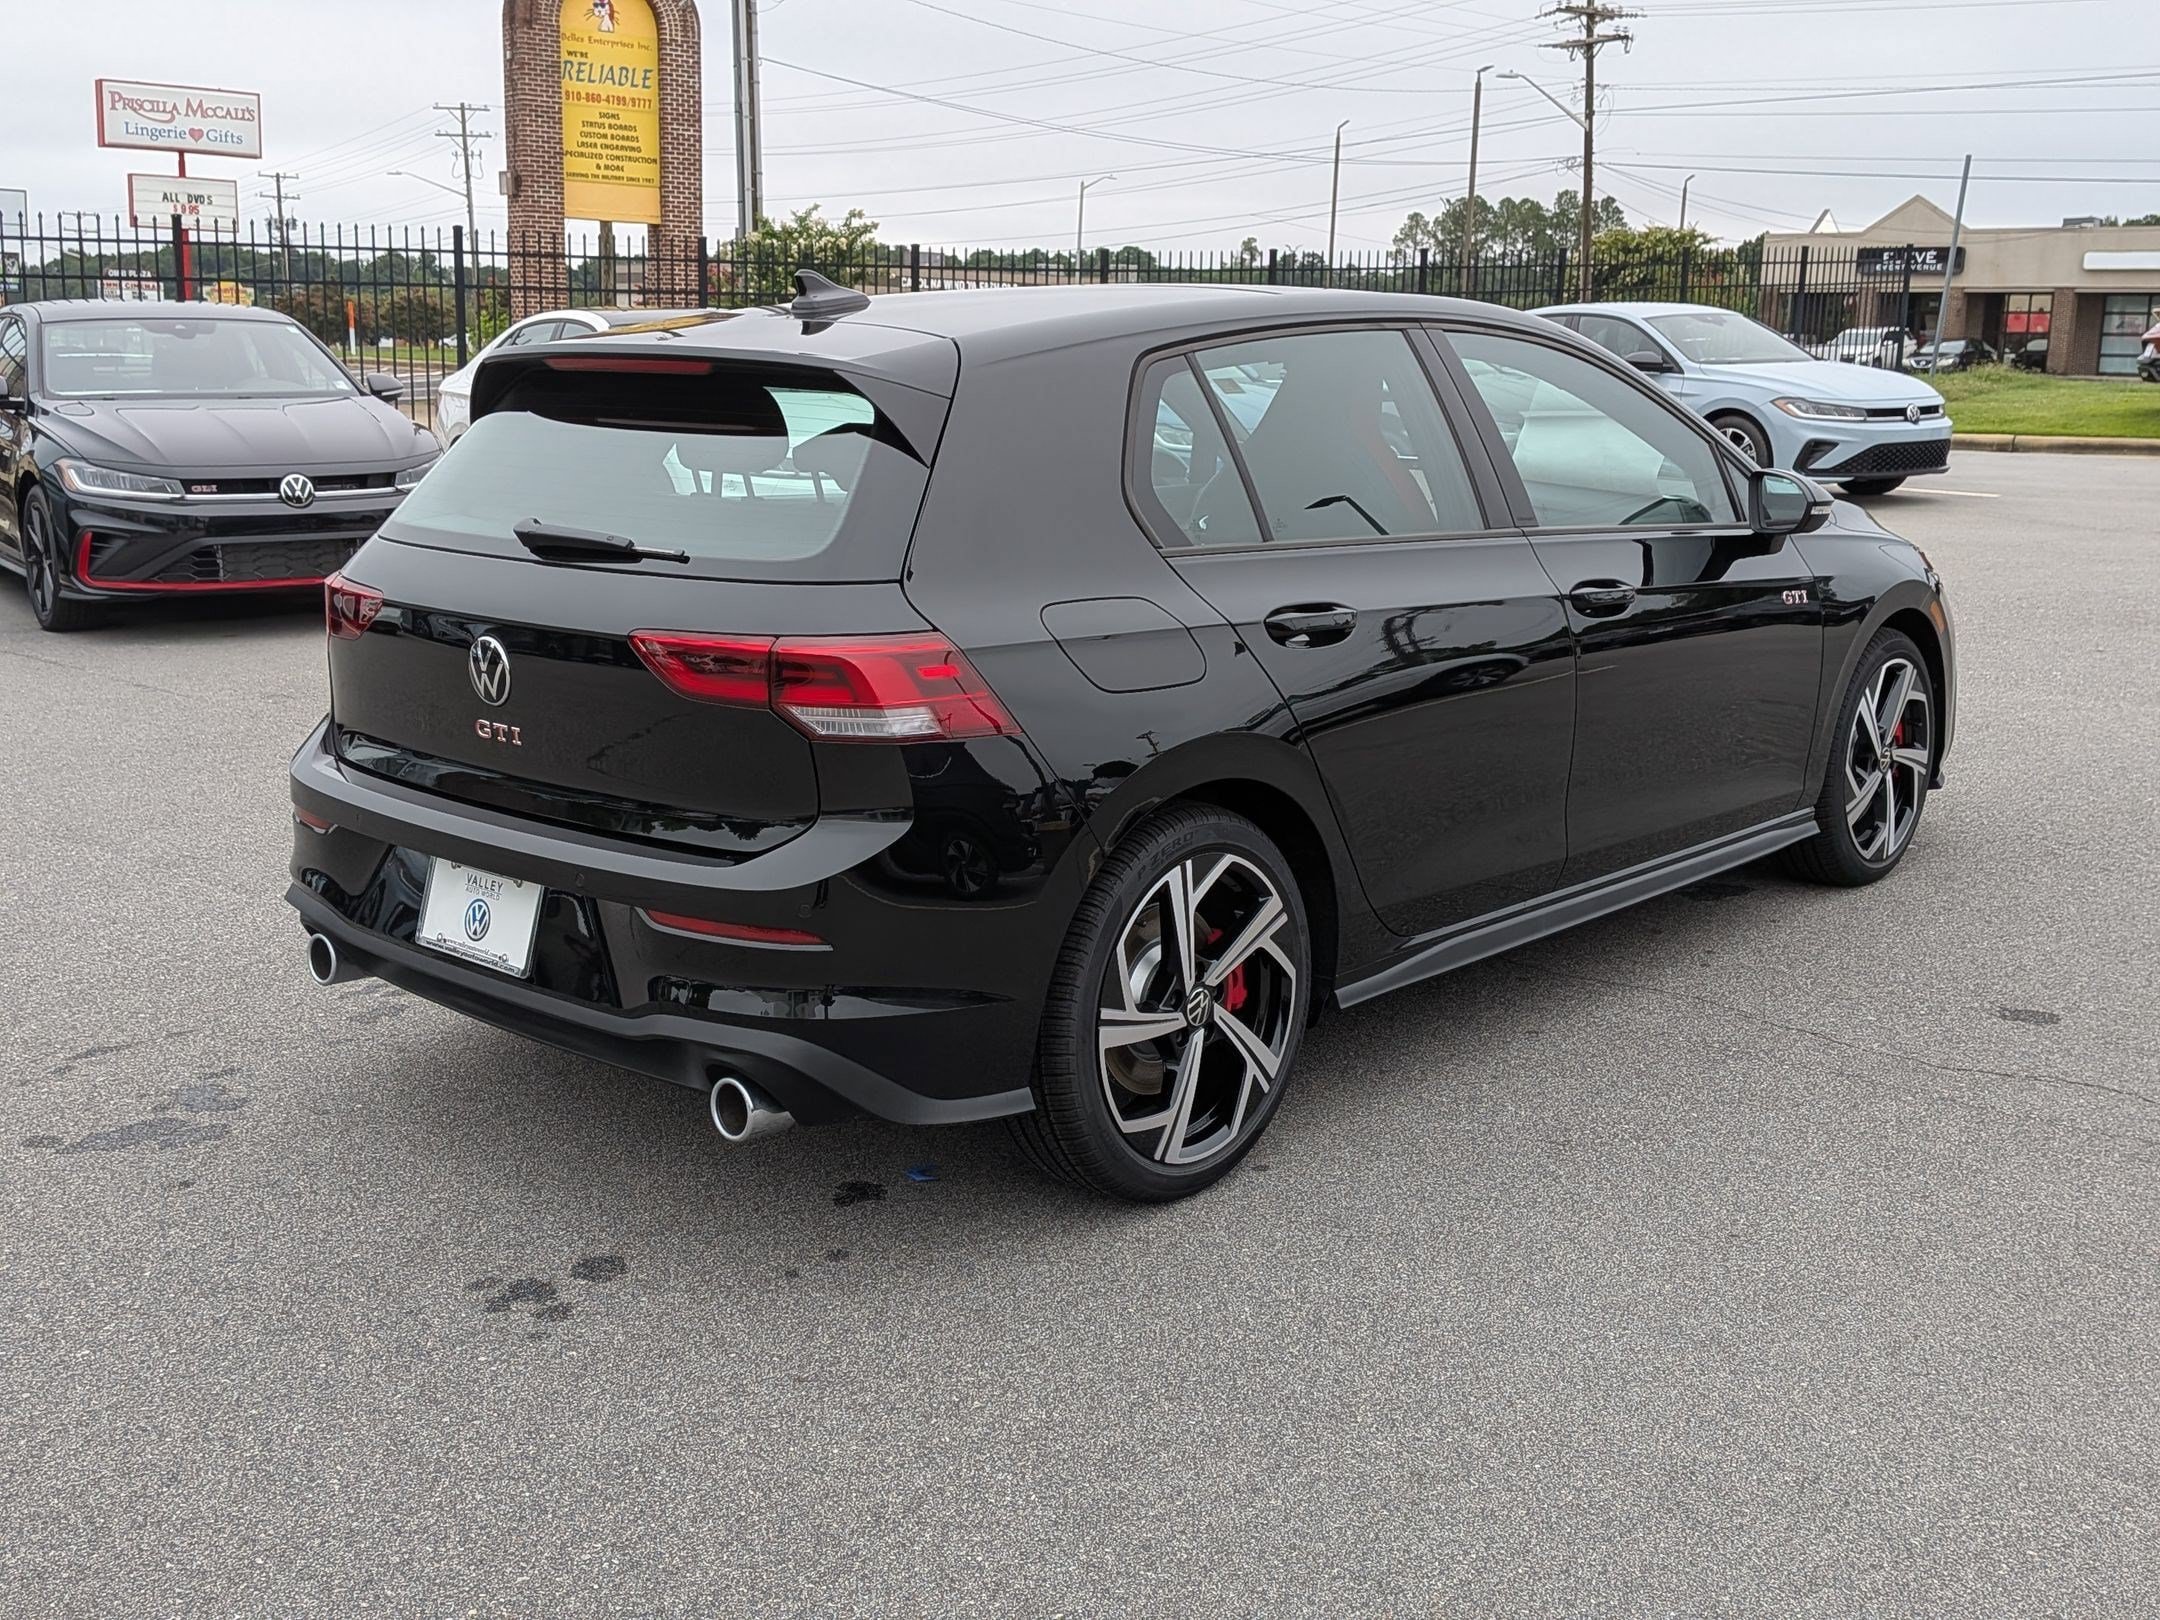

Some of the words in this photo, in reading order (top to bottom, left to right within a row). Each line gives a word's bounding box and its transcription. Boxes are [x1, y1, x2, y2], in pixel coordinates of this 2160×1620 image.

[562, 60, 654, 89] RELIABLE
[599, 111, 620, 120] SIGNS
[581, 120, 606, 130] STATUS
[608, 123, 637, 132] BOARDS
[124, 122, 187, 141] Lingerie
[206, 129, 244, 145] Gifts
[580, 130, 608, 140] CUSTOM
[610, 133, 640, 143] BOARDS
[576, 141, 598, 150] LASER
[600, 142, 643, 153] ENGRAVING
[605, 153, 658, 165] CONSTRUCTION
[604, 163, 625, 172] MORE
[162, 192, 180, 203] ALL
[1782, 590, 1808, 604] GTI
[475, 719, 522, 746] GTI
[466, 873, 504, 893] VALLEY
